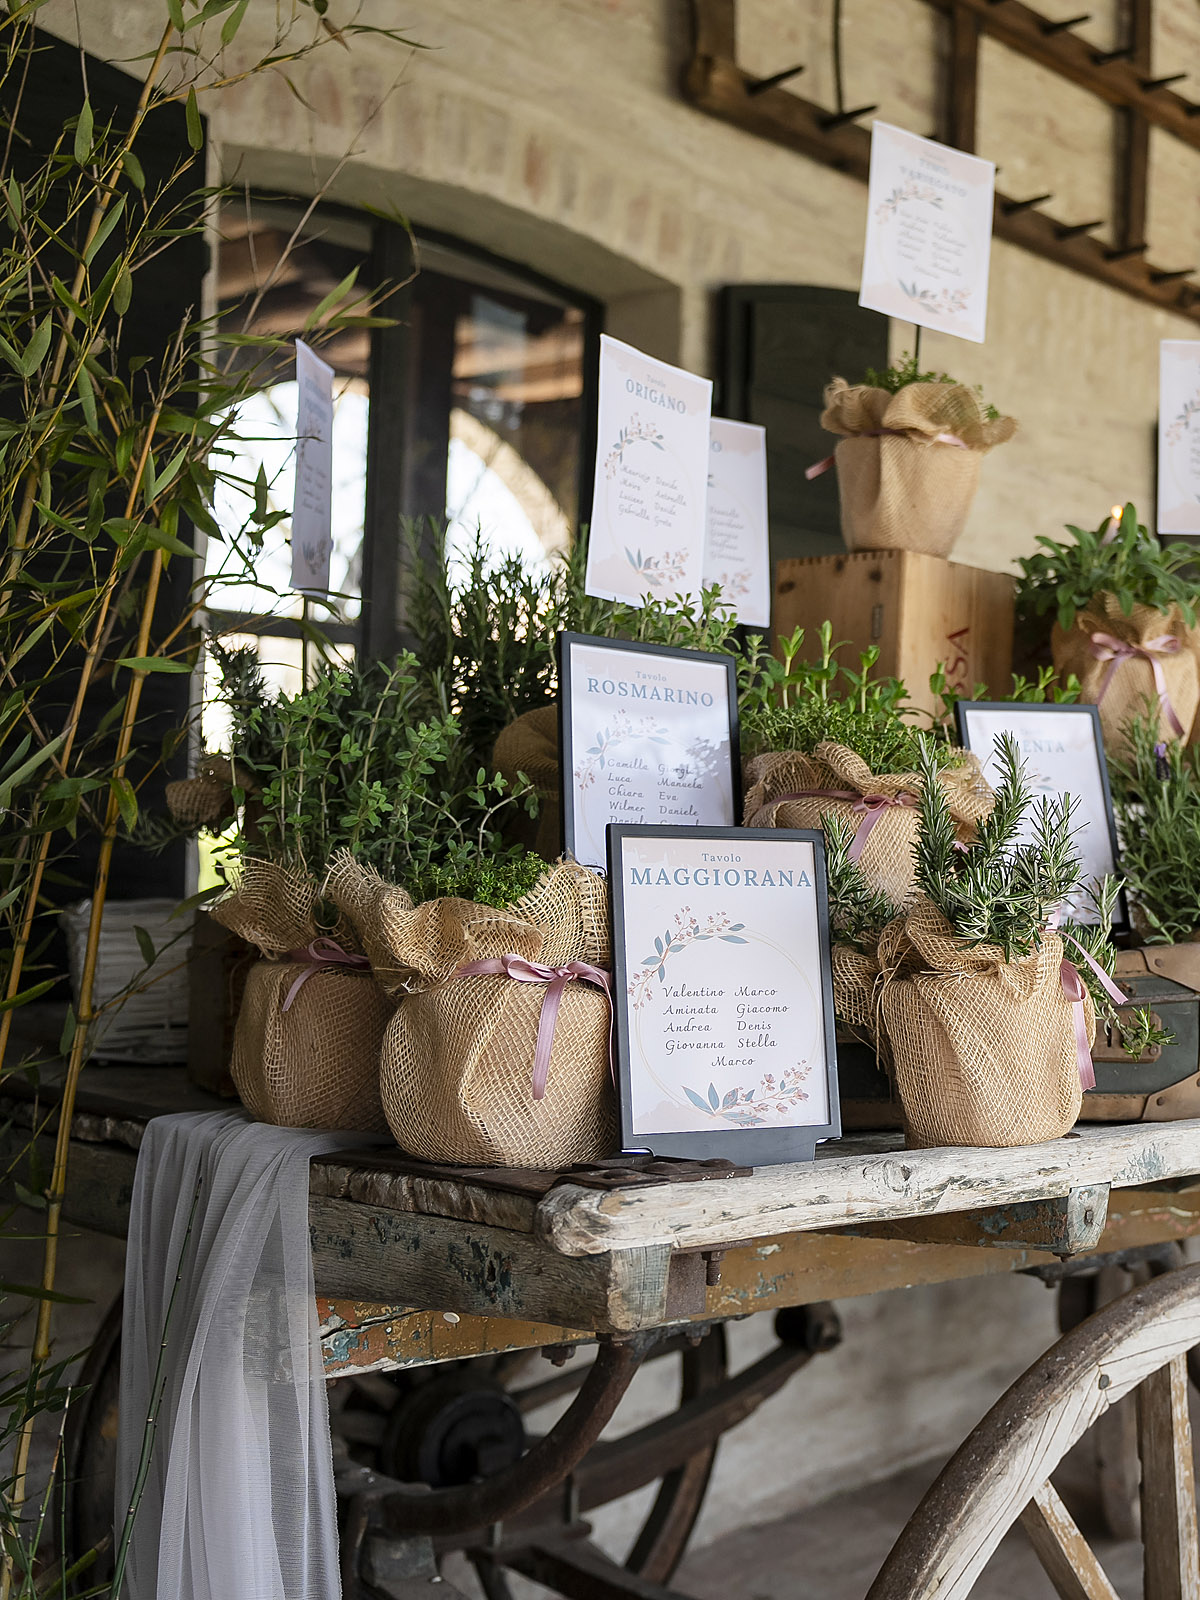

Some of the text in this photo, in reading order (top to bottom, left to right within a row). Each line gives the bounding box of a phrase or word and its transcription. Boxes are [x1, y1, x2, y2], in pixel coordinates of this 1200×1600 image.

[625, 378, 687, 414] ORIGANO
[635, 670, 667, 682] Tavolo
[587, 676, 715, 708] ROSMARINO
[1022, 738, 1066, 753] ENTA
[607, 757, 650, 771] Camilla
[607, 772, 705, 791] Luca Manuela
[608, 784, 679, 801] Chiara Eva
[609, 799, 700, 817] Wilmer Daniele
[701, 852, 742, 864] Tavolo
[630, 866, 812, 888] MAGGIORANA
[662, 983, 779, 998] Valentino Marco
[662, 1004, 791, 1019] Aminata Giacomo
[663, 1017, 772, 1033] Andrea Denis
[665, 1034, 778, 1056] Giovanna Stella
[711, 1055, 756, 1067] Marco
